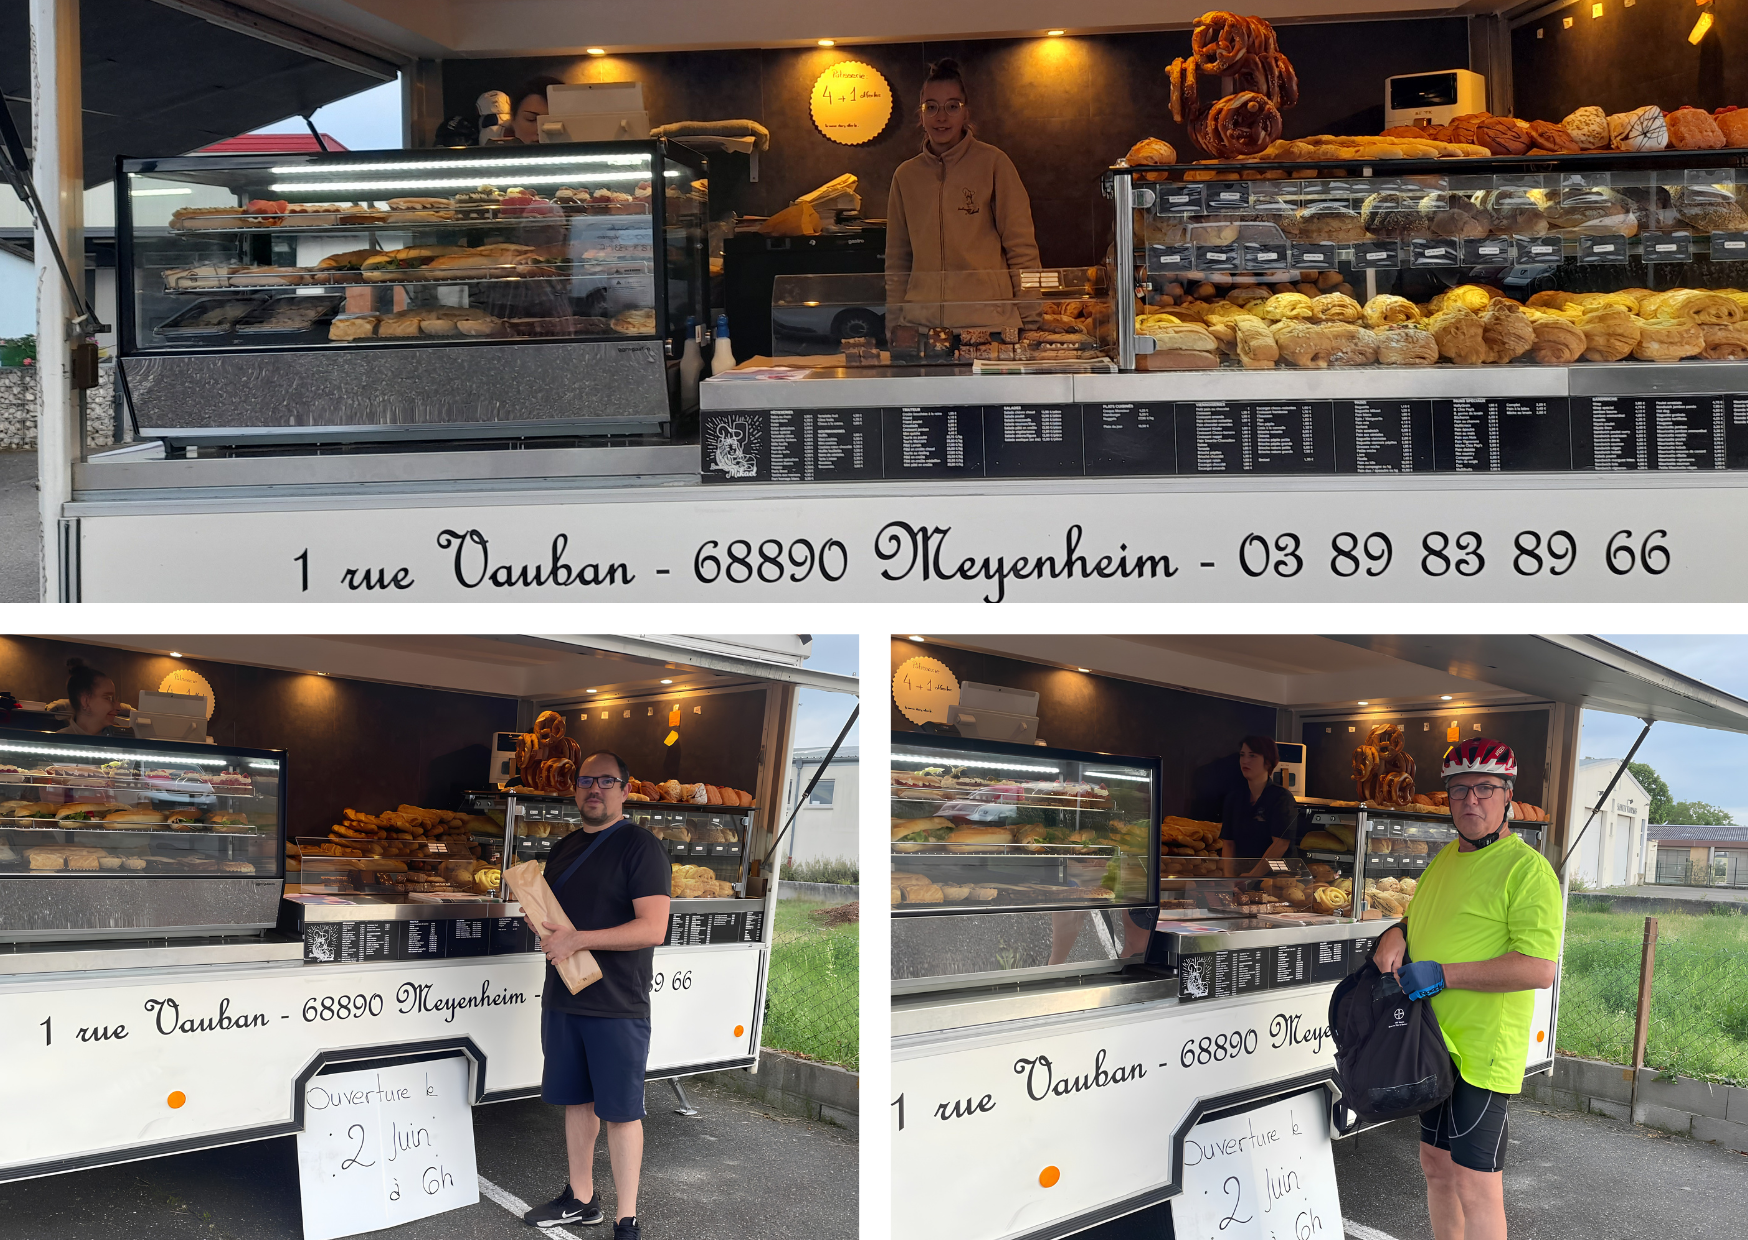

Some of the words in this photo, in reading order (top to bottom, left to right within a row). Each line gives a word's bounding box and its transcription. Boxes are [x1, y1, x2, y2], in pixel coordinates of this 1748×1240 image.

[823, 85, 832, 105] 4
[850, 86, 856, 101] 1
[294, 548, 308, 591] 1
[341, 568, 414, 590] rue
[437, 529, 635, 588] Vauban
[694, 538, 847, 583] 68890
[875, 521, 1178, 602] Meyenheim
[1240, 533, 1303, 577] 03
[1331, 532, 1392, 577] 89
[1422, 531, 1485, 576] 83
[1514, 530, 1576, 576] 89
[1606, 530, 1670, 575] 66
[903, 673, 911, 691] 4
[927, 679, 932, 691] 1
[40, 1016, 52, 1046] 1
[75, 1024, 129, 1043] rue
[145, 998, 270, 1036] Vauban
[302, 992, 384, 1023] 68890
[396, 979, 527, 1023] Meyenheim
[650, 972, 665, 992] 9
[672, 970, 692, 991] 66
[306, 1073, 411, 1110] Ouverture
[425, 1072, 438, 1097] le
[891, 1092, 904, 1132] 1
[933, 1094, 997, 1121] rue
[1013, 1048, 1147, 1101] Vauban
[1180, 1028, 1258, 1069] 68890
[341, 1123, 376, 1170] 2
[1184, 1117, 1280, 1166] Ouverture
[1290, 1109, 1303, 1136] le
[389, 1178, 401, 1201] à
[422, 1165, 454, 1195] 6h
[1219, 1175, 1253, 1231] 2
[1295, 1208, 1322, 1240] 6h
